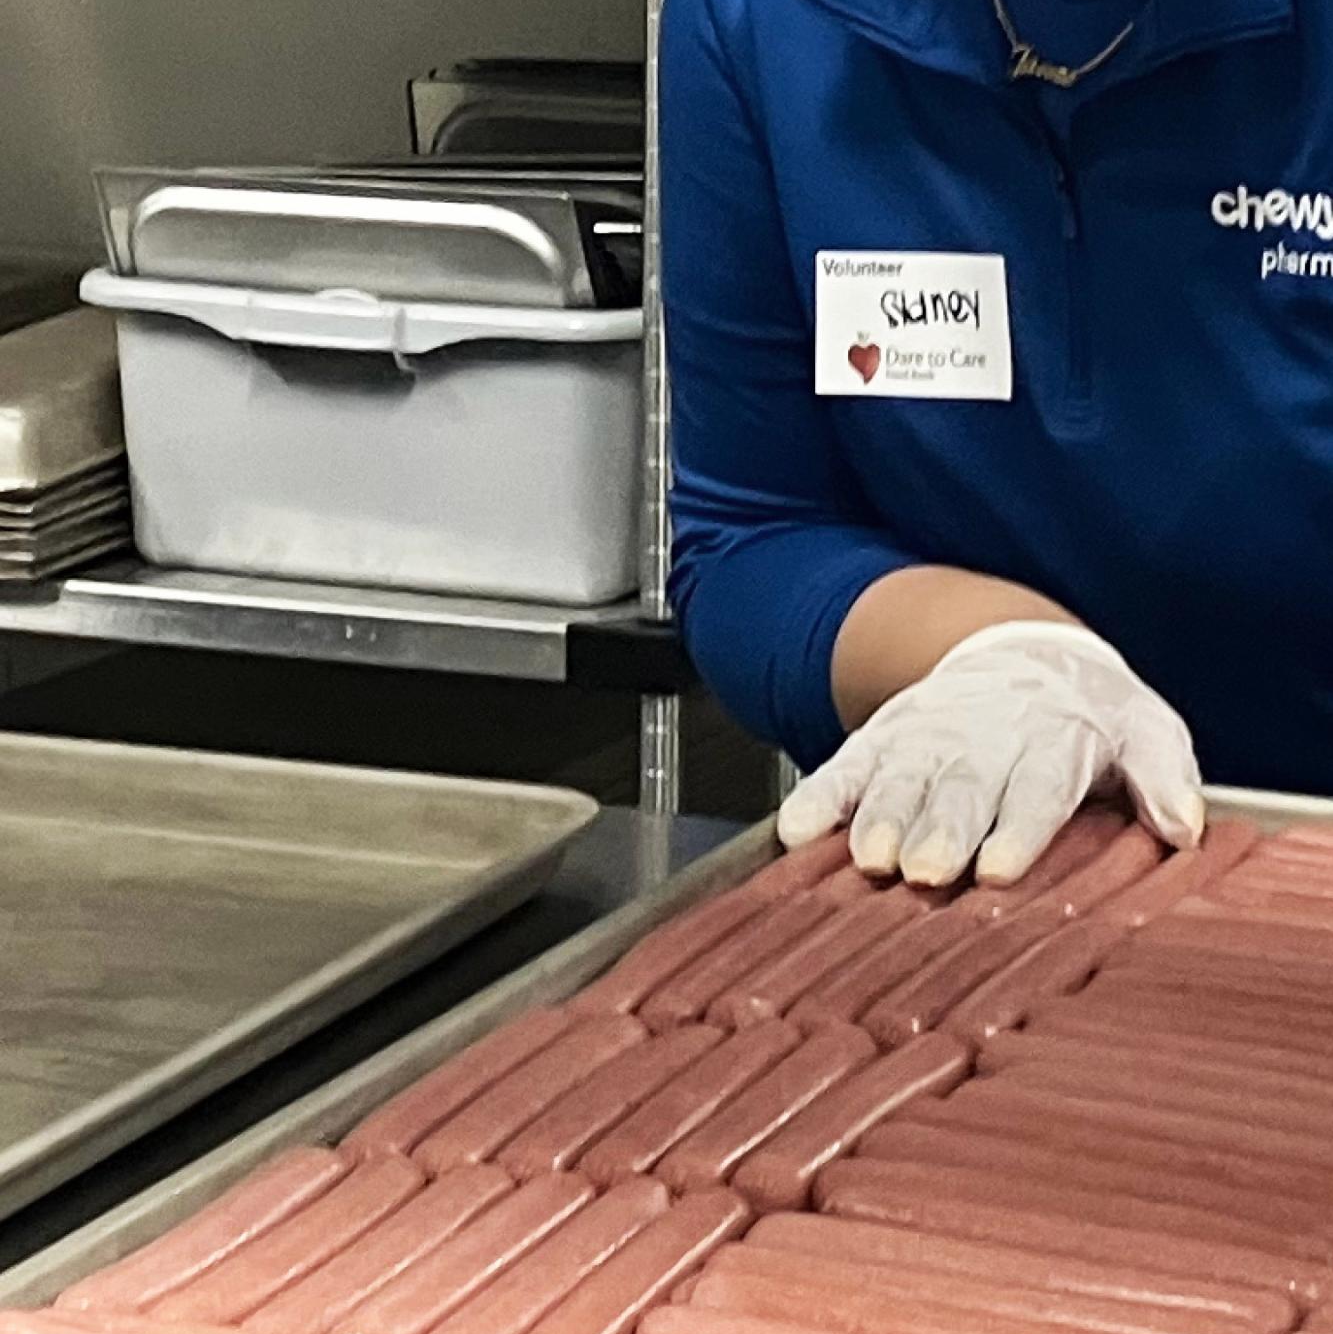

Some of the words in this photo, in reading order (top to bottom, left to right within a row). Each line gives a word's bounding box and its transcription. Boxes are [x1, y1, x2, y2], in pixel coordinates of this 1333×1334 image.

[823, 259, 903, 277] Volunteer
[881, 289, 981, 331] Sidney
[886, 346, 924, 368] Dare
[928, 350, 946, 368] to
[949, 348, 986, 369] Care
